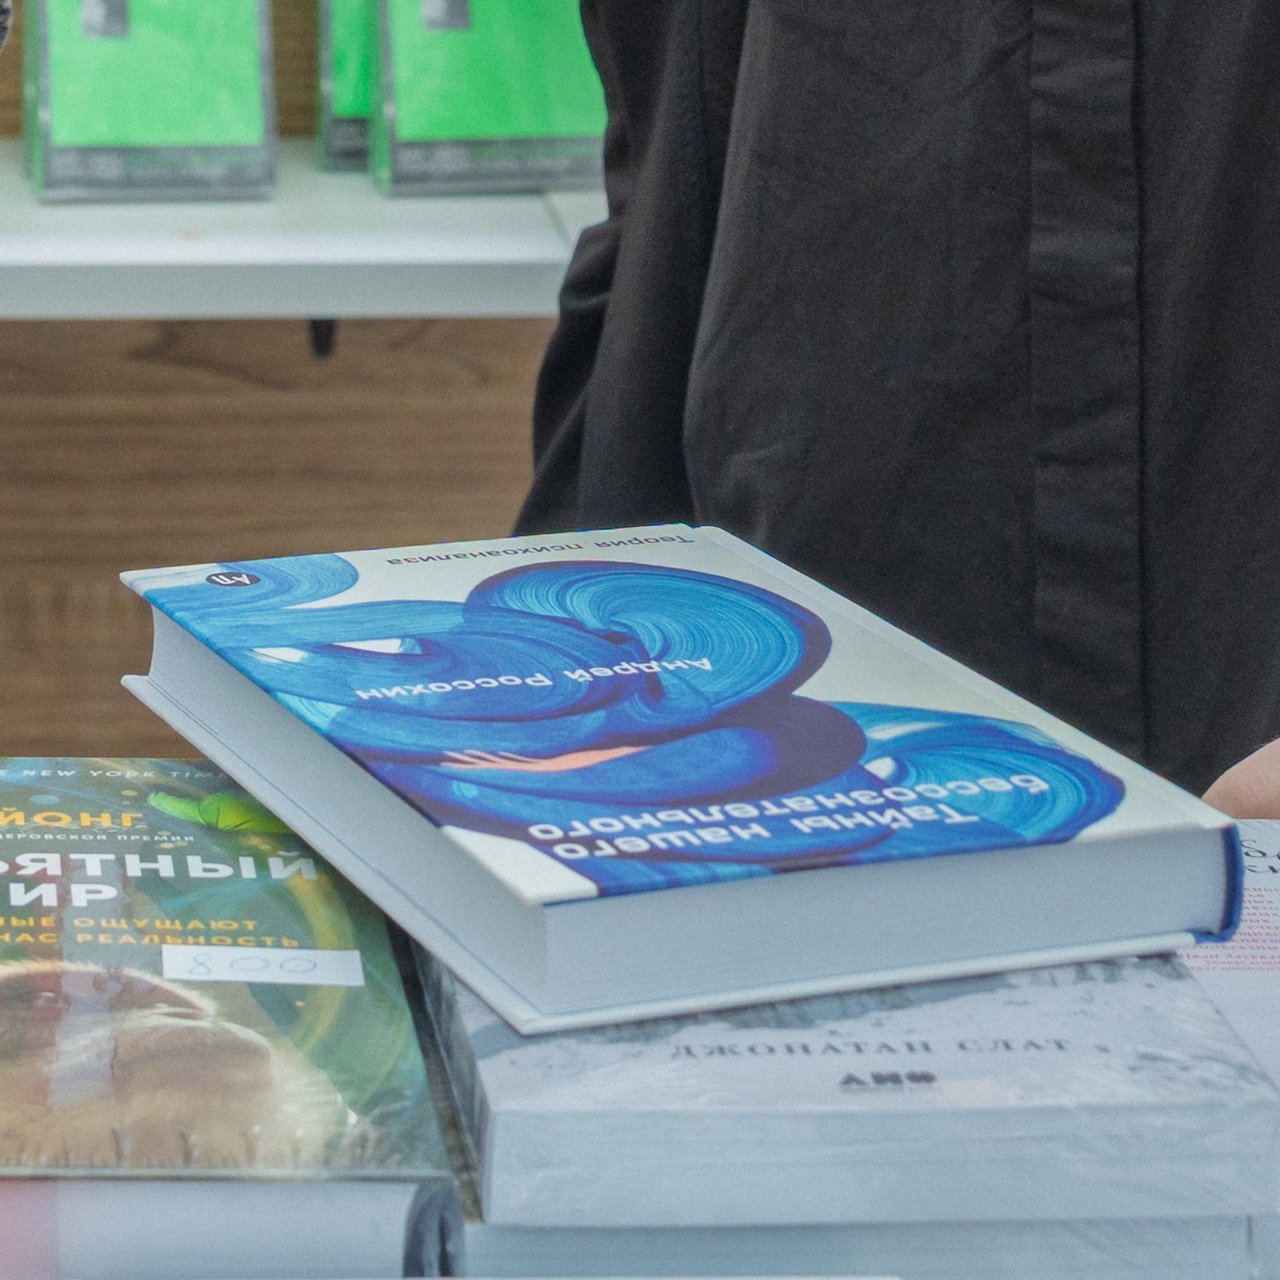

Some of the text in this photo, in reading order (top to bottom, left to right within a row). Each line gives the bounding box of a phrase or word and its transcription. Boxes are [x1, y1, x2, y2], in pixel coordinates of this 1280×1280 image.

[385, 534, 697, 566] Теория психоанализа
[354, 655, 715, 701] Андрей Россохин
[90, 770, 156, 779] YORK
[527, 772, 1052, 842] бессознательного
[0, 832, 195, 842] ЕРОВСКОЙ ПРЕМИИ
[551, 801, 981, 861] Тайны нашего
[0, 851, 319, 881] ЯТНЫЙ
[73, 917, 259, 932] ОЩУЩАЮТ
[76, 933, 300, 948] РЕАЛЬНОСТЬ
[187, 952, 319, 976] 800
[670, 1038, 1069, 1060] ДЖОНАТАН СЛАТ
